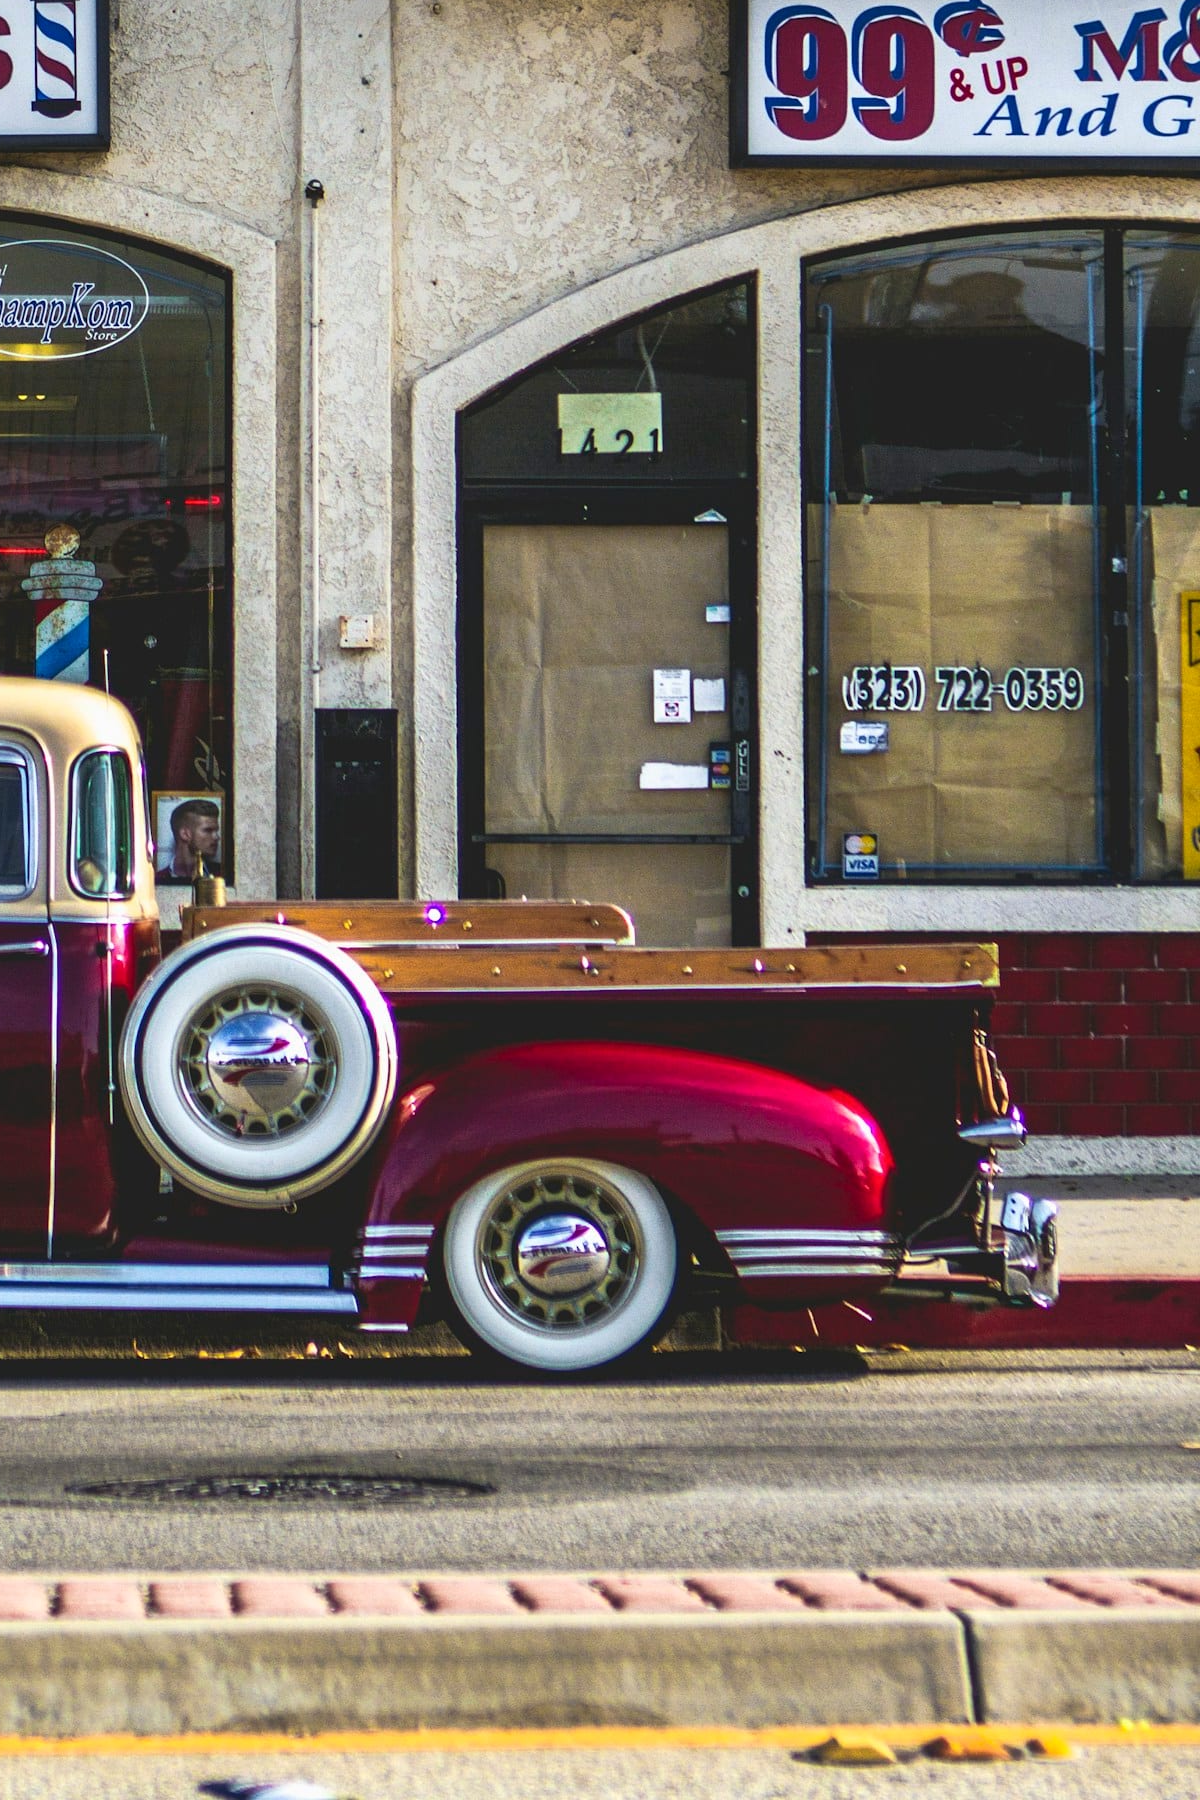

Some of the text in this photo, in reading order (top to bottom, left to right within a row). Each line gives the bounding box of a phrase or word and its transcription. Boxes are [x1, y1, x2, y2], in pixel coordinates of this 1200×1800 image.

[950, 55, 1029, 103] & UP
[973, 93, 1120, 137] And
[85, 328, 118, 342] Store
[842, 666, 1085, 713] (323) 722-0359
[848, 858, 876, 871] VISA
